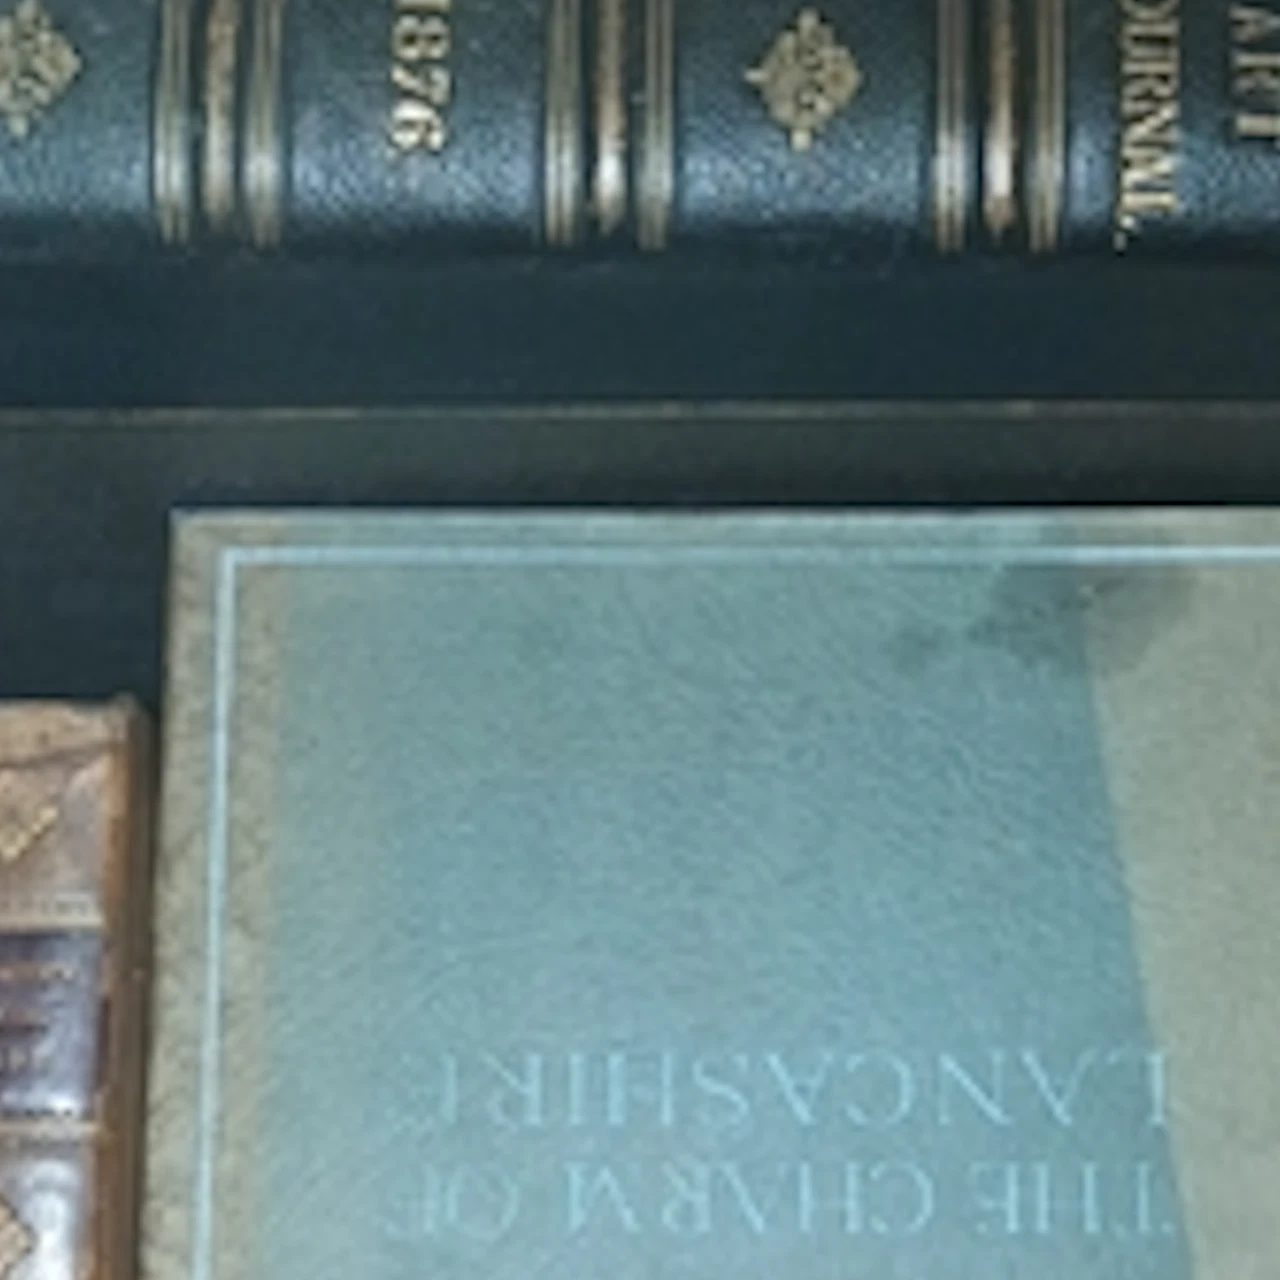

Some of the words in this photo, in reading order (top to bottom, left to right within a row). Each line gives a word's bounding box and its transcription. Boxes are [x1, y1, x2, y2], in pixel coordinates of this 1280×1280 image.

[387, 1048, 1167, 1129] LANCASHIRE
[387, 1160, 520, 1240] OF
[564, 1160, 934, 1236] CHARM
[968, 1160, 1176, 1237] THE
